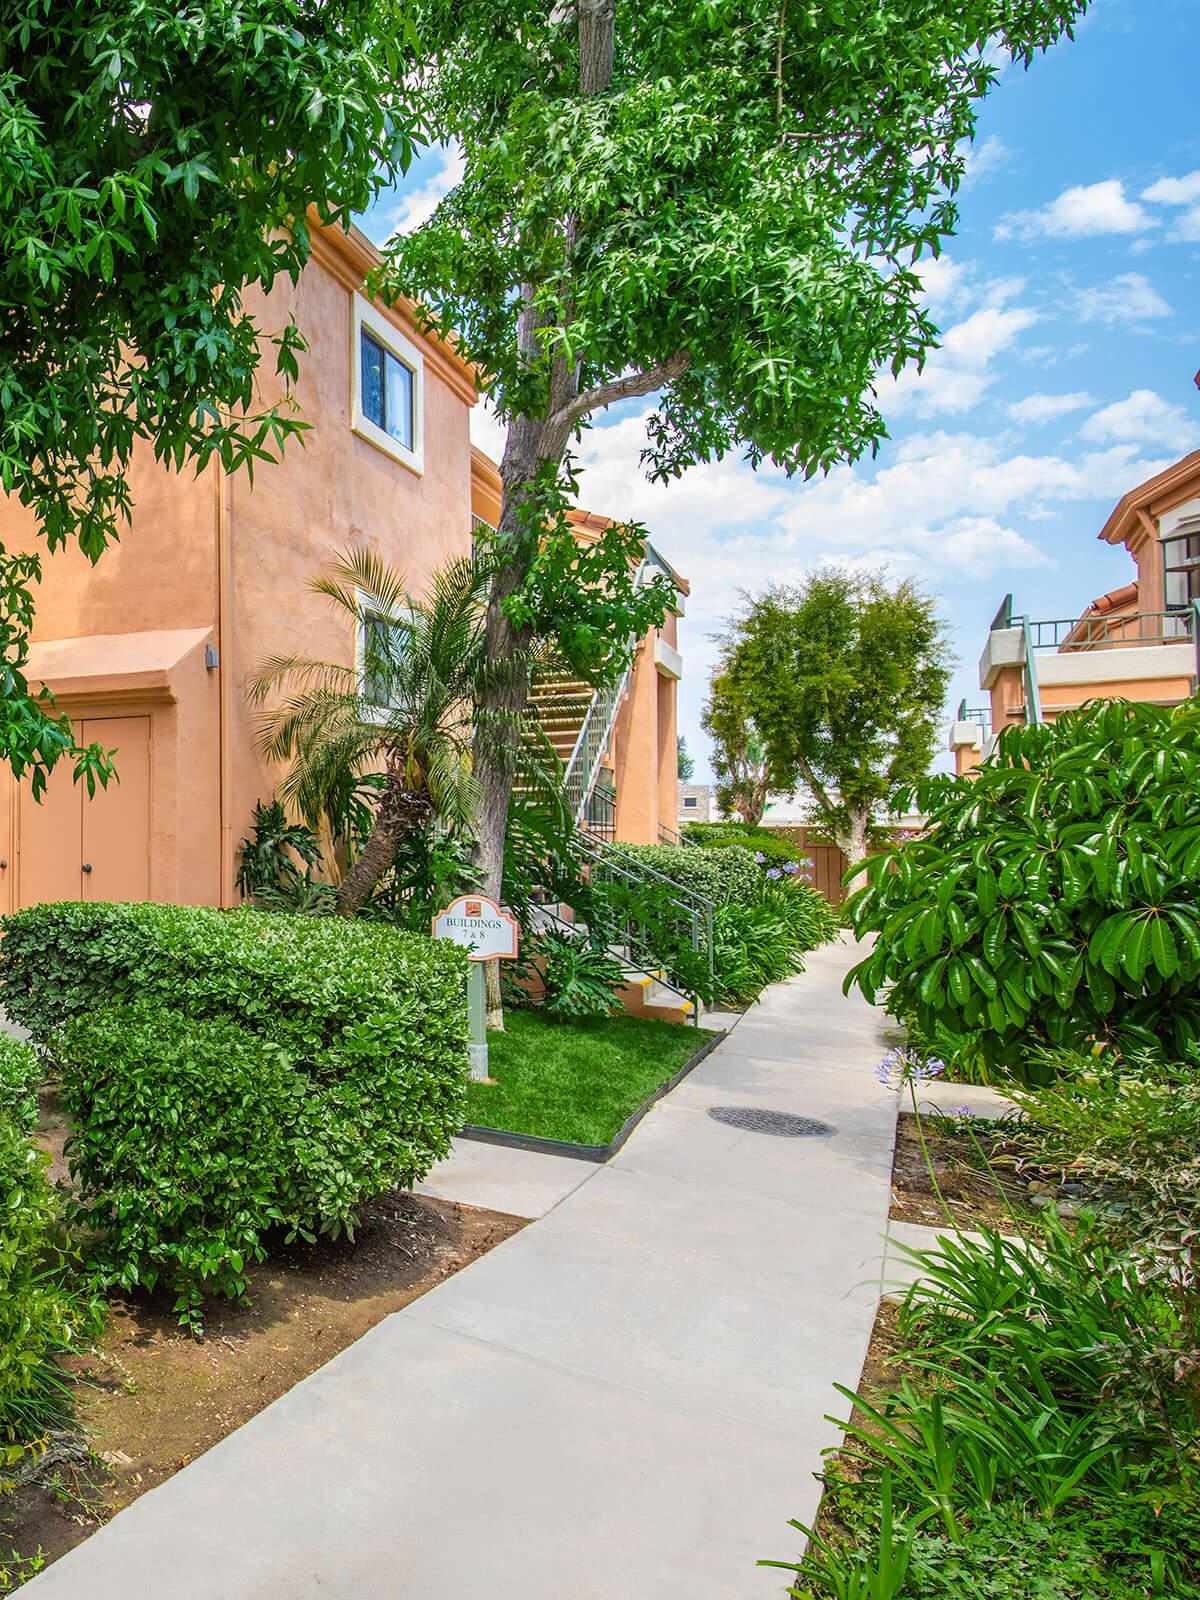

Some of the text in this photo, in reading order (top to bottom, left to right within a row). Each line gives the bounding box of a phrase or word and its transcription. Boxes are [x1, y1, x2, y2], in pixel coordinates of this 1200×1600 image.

[446, 918, 502, 929] BUILDINGS
[462, 929, 468, 938] 7
[479, 930, 486, 939] 8
